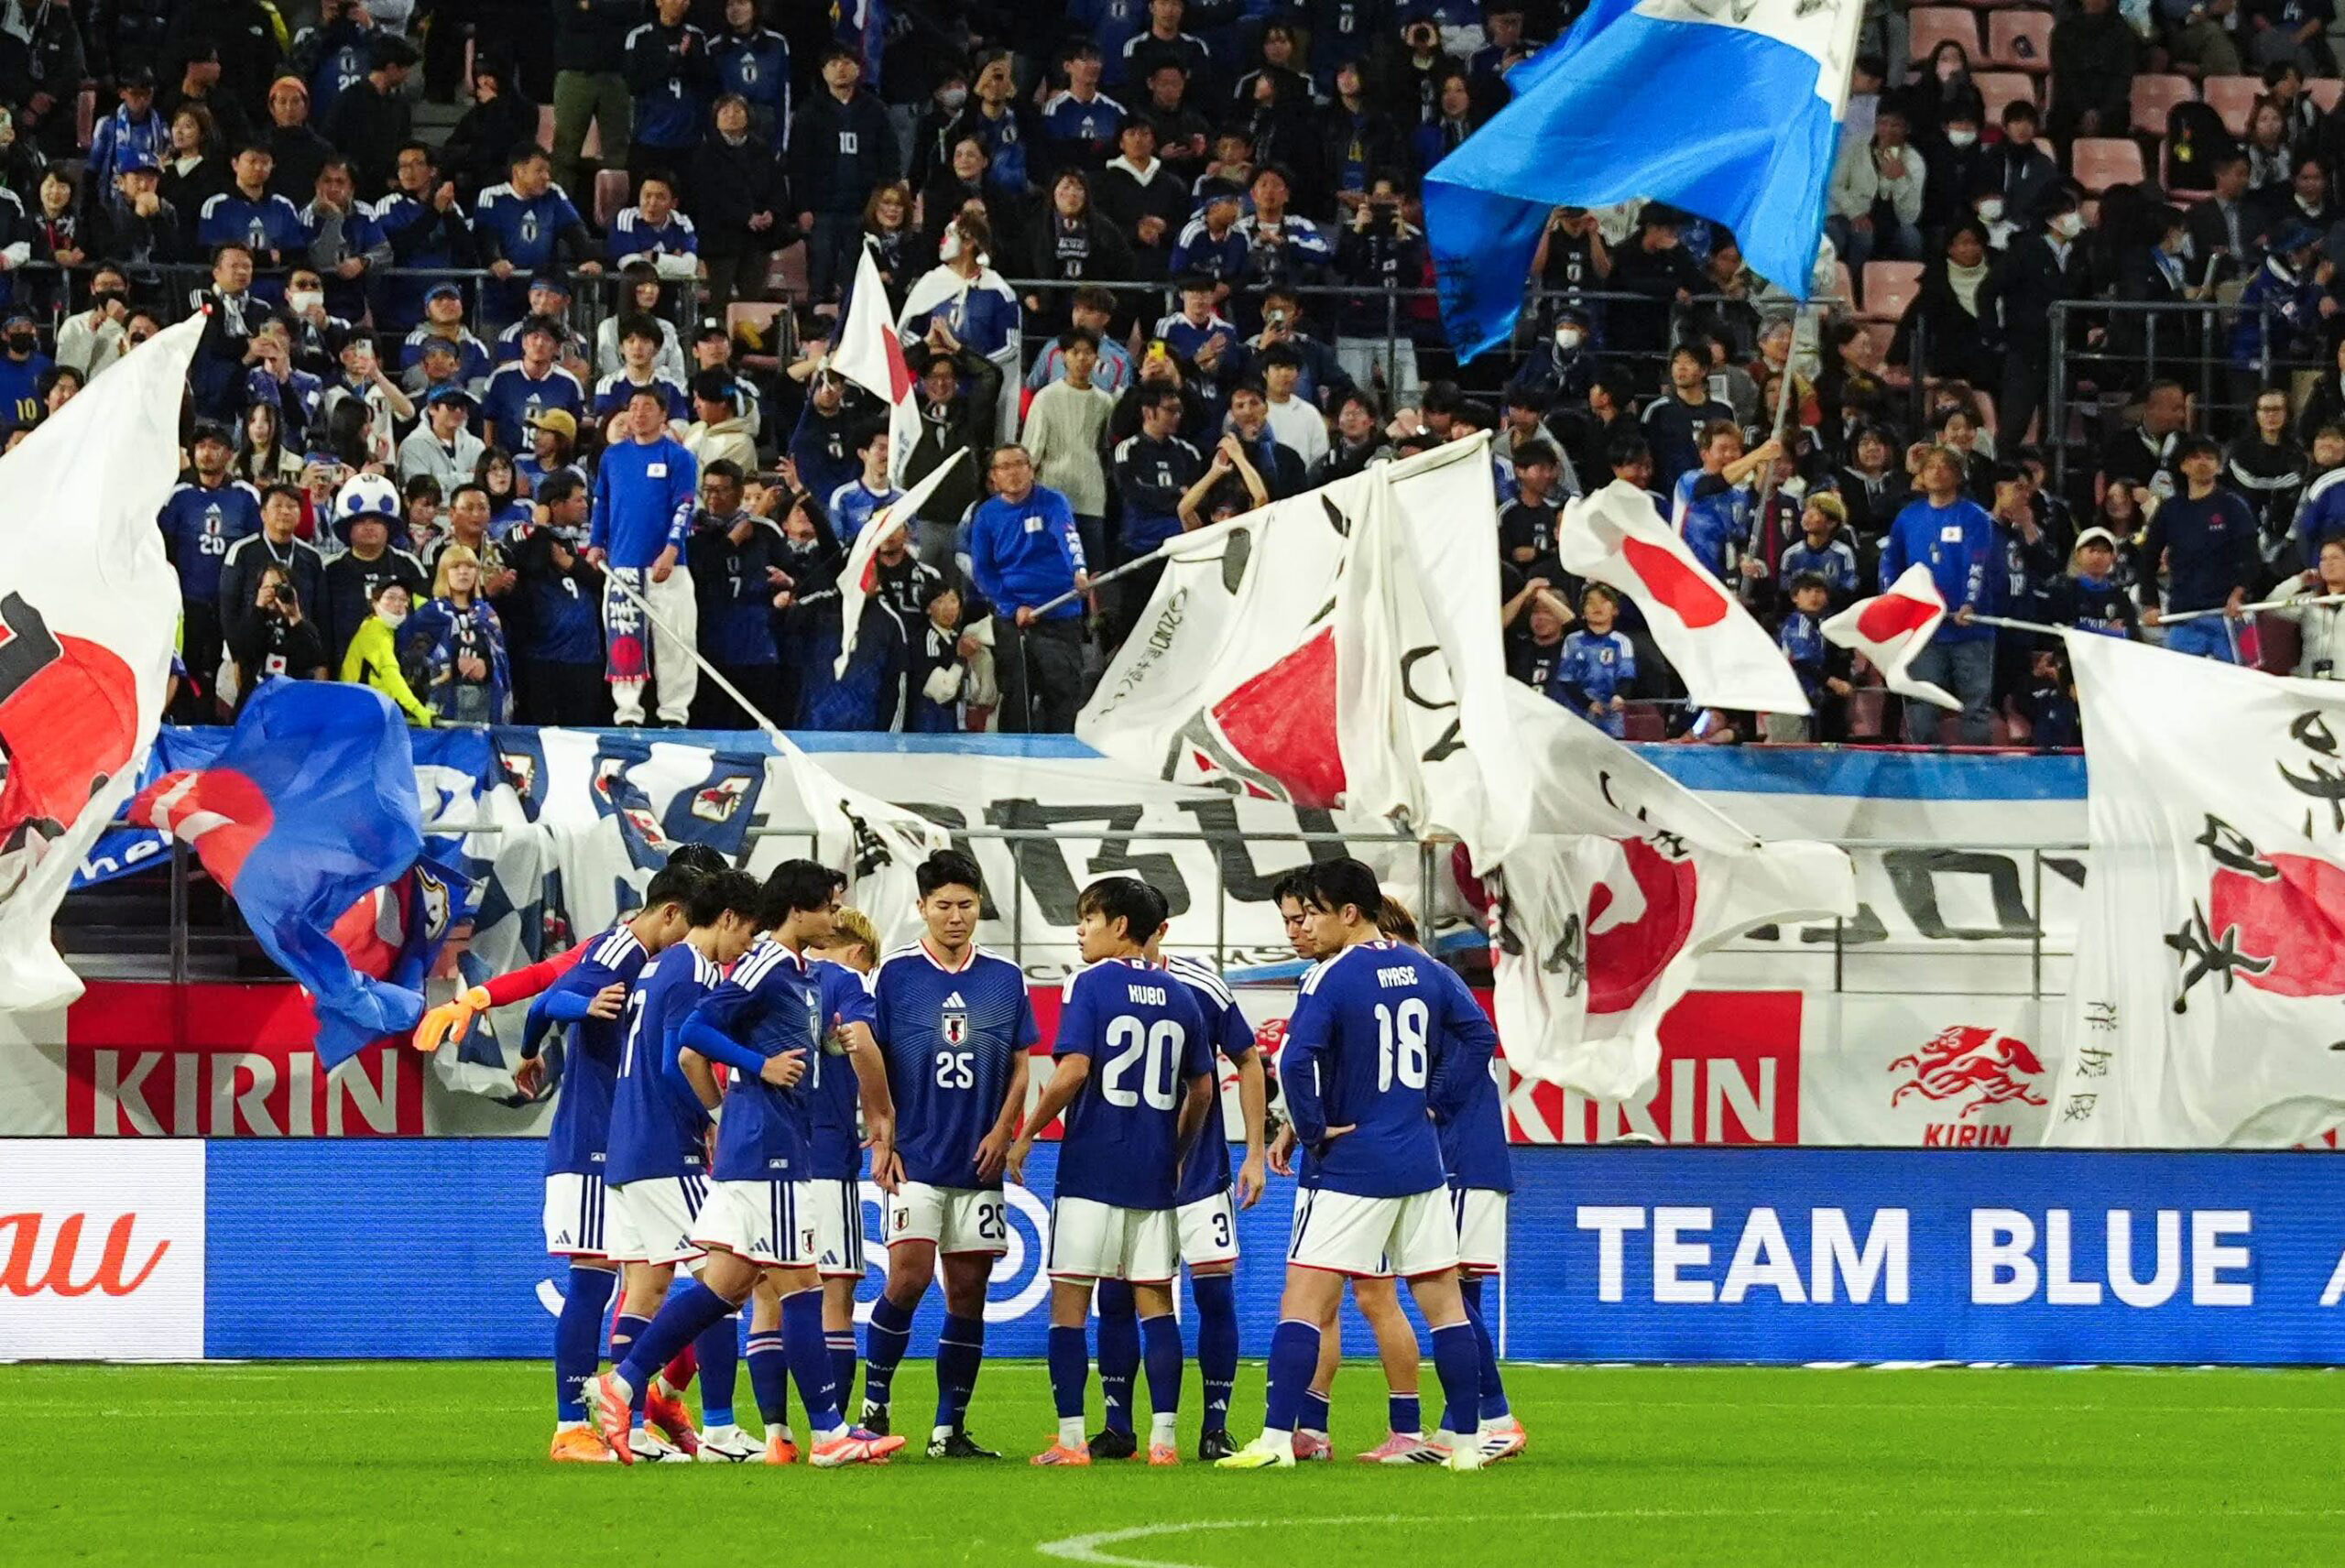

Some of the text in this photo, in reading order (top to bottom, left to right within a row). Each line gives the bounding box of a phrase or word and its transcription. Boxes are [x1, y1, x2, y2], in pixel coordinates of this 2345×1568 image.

[839, 132, 858, 154] 10
[16, 397, 37, 421] 10
[199, 535, 226, 555] 20
[562, 576, 579, 599] 9
[728, 576, 742, 598] 7
[1376, 965, 1419, 988] AYASE
[1128, 984, 1167, 1007] KUBO
[1374, 997, 1429, 1094] 18
[935, 1051, 974, 1089] 25
[1101, 1015, 1185, 1111] 20
[93, 1049, 398, 1137] KIRIN
[1924, 1123, 2012, 1147] KIRIN
[977, 1203, 1007, 1239] 25
[1212, 1212, 1230, 1247] 3
[1576, 1205, 1909, 1305] TEAM
[1969, 1209, 2253, 1308] BLUE
